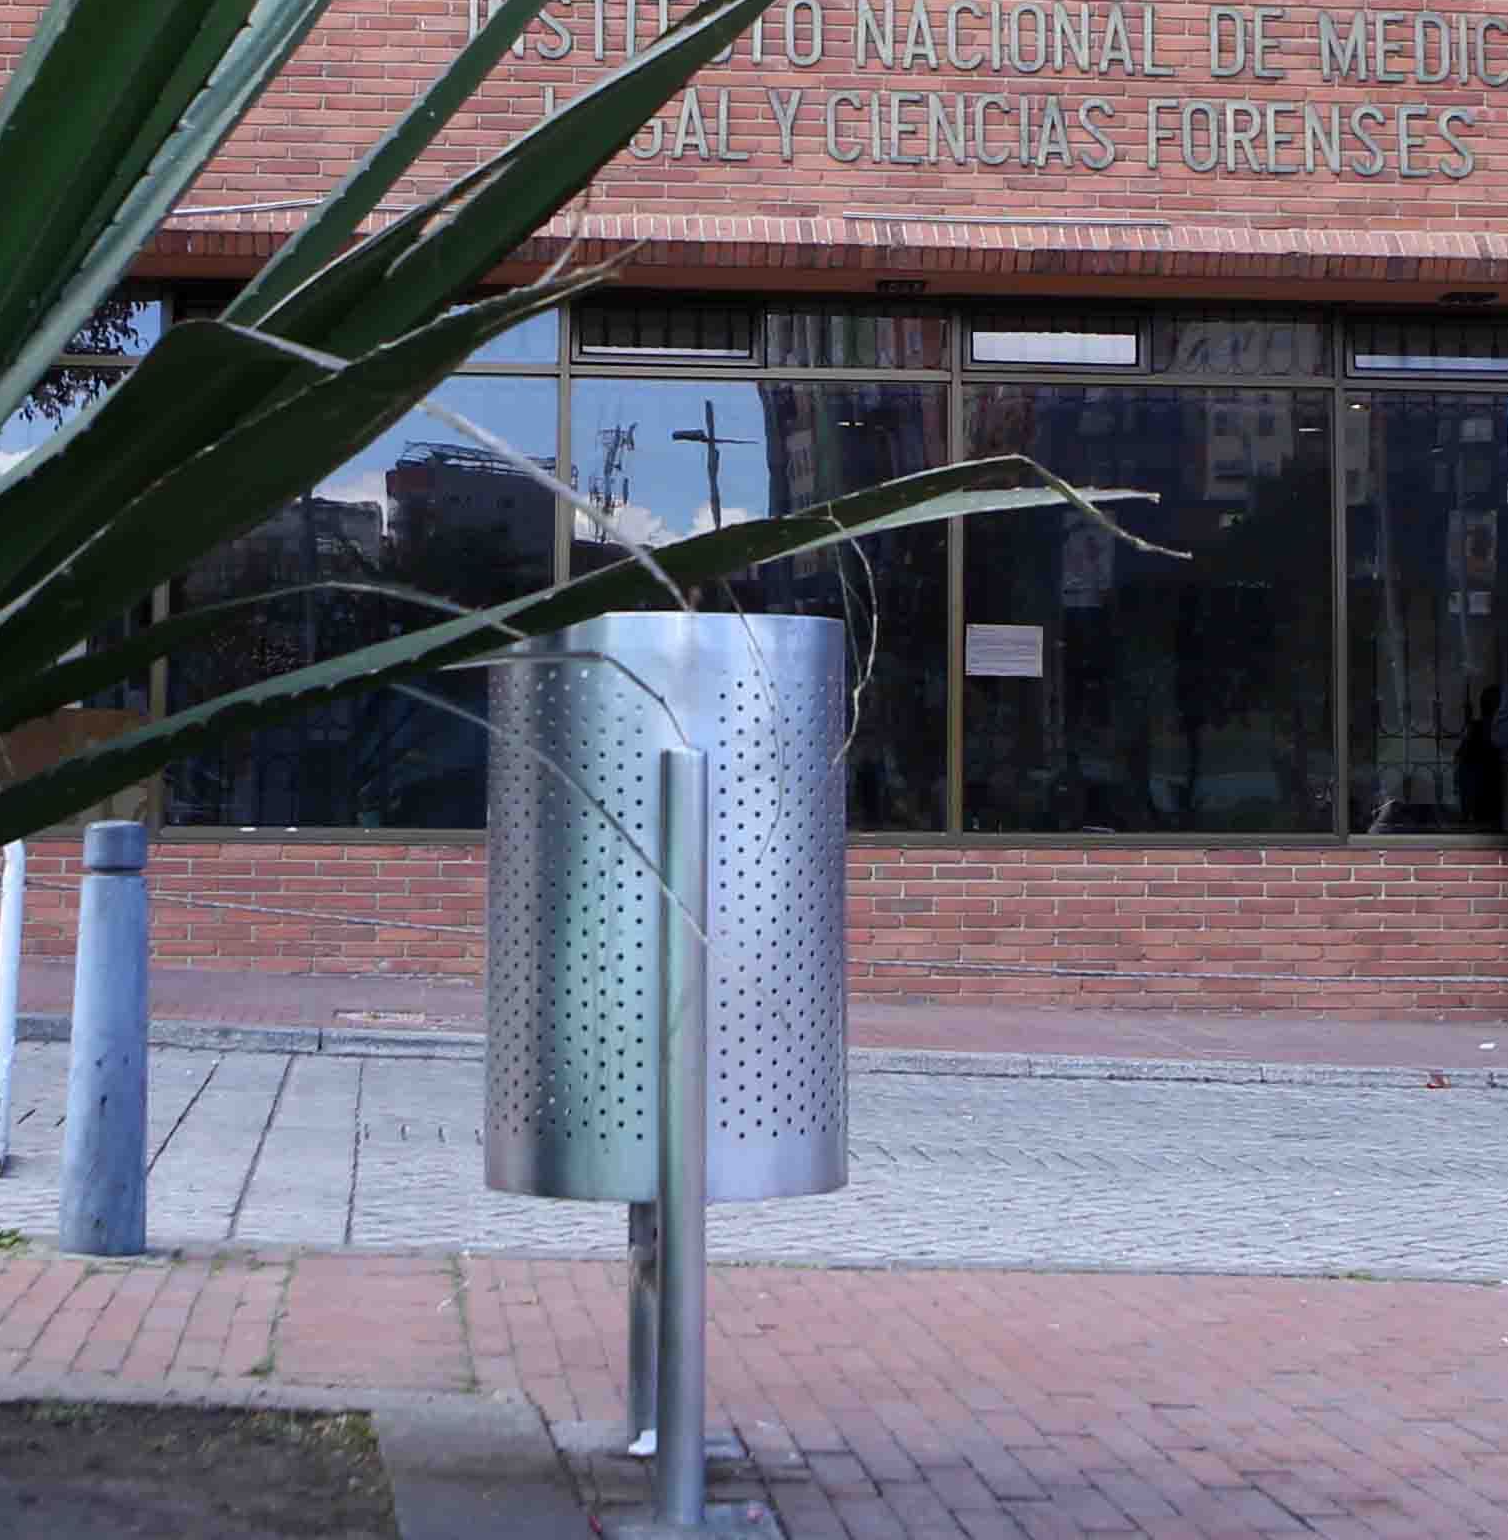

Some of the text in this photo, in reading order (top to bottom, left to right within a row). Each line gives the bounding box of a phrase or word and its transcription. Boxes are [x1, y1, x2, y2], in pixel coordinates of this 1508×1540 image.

[1208, 5, 1285, 79] DE
[769, 88, 802, 161] Y
[826, 92, 1116, 171] CIENCIAS
[1147, 98, 1476, 179] FORENSES
